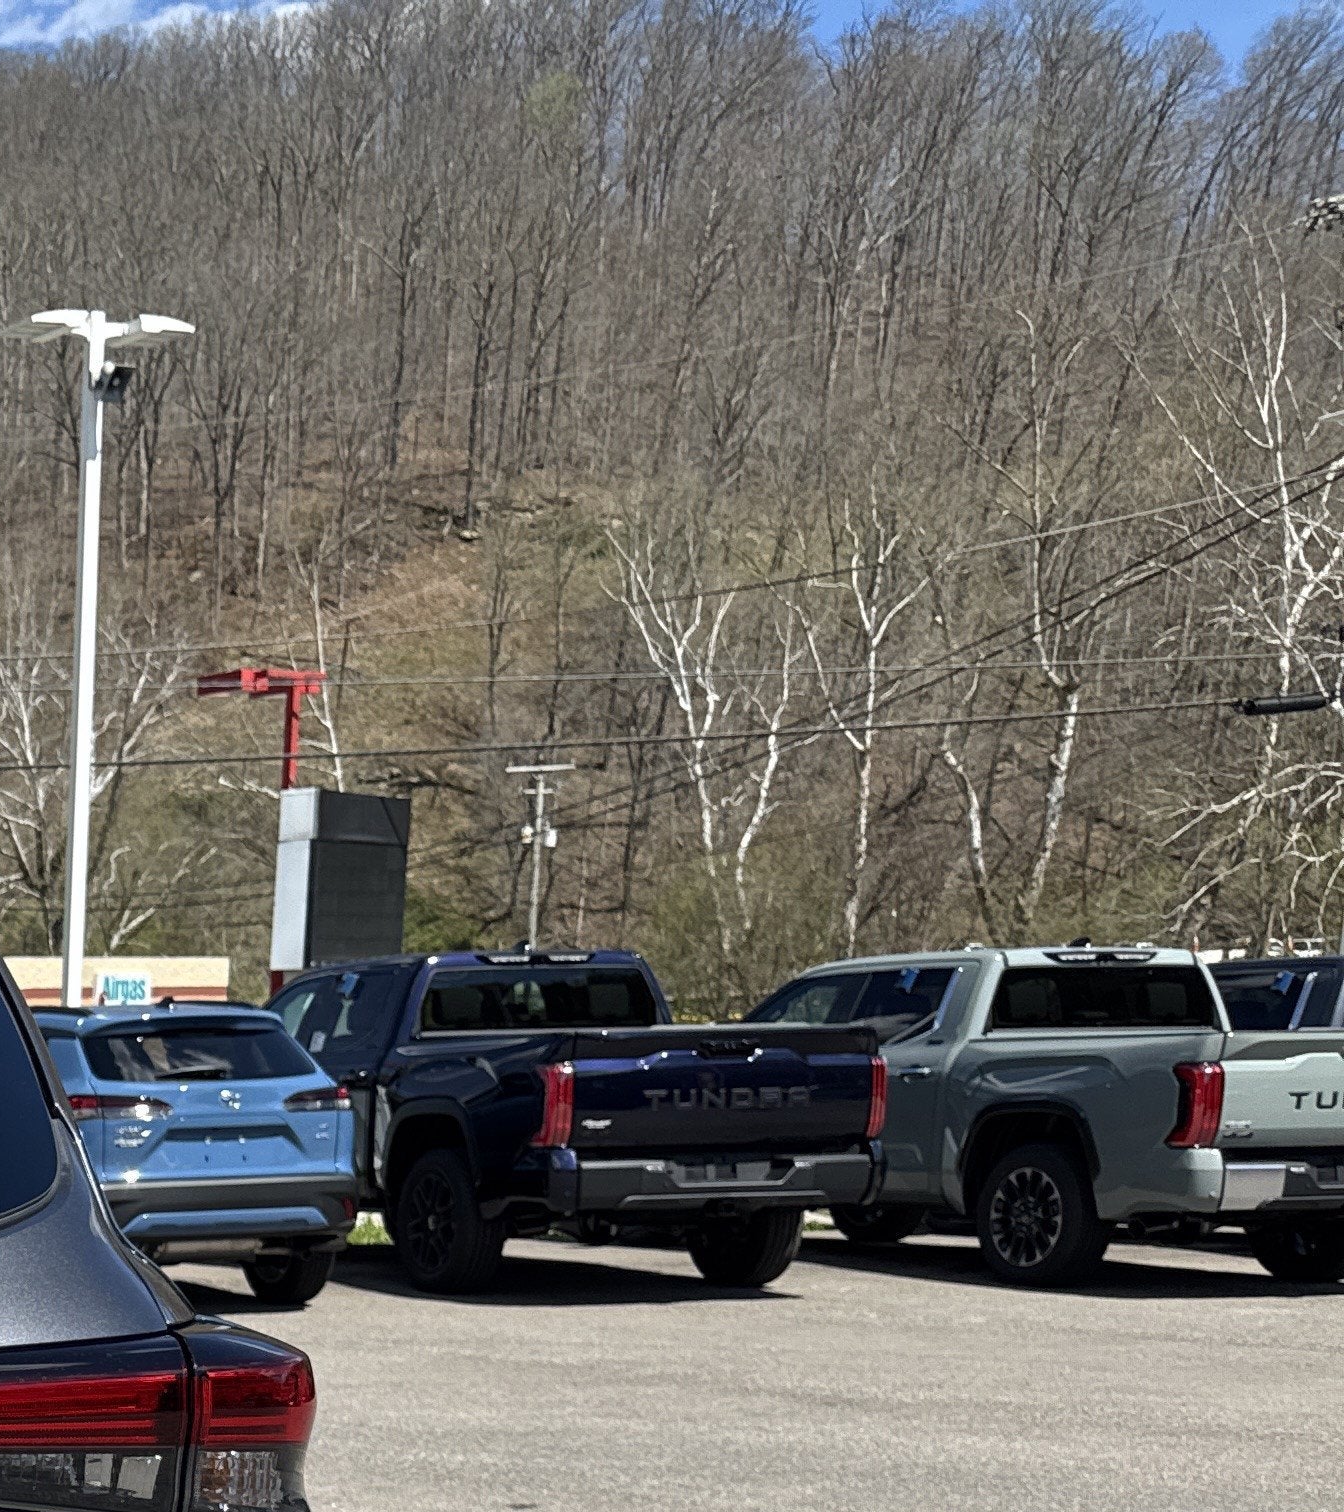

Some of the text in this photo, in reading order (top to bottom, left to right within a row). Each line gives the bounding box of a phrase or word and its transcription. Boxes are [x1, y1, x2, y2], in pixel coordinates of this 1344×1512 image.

[102, 976, 146, 1006] Airgas
[642, 1085, 820, 1111] TUNDRA
[1288, 1090, 1344, 1110] TU
